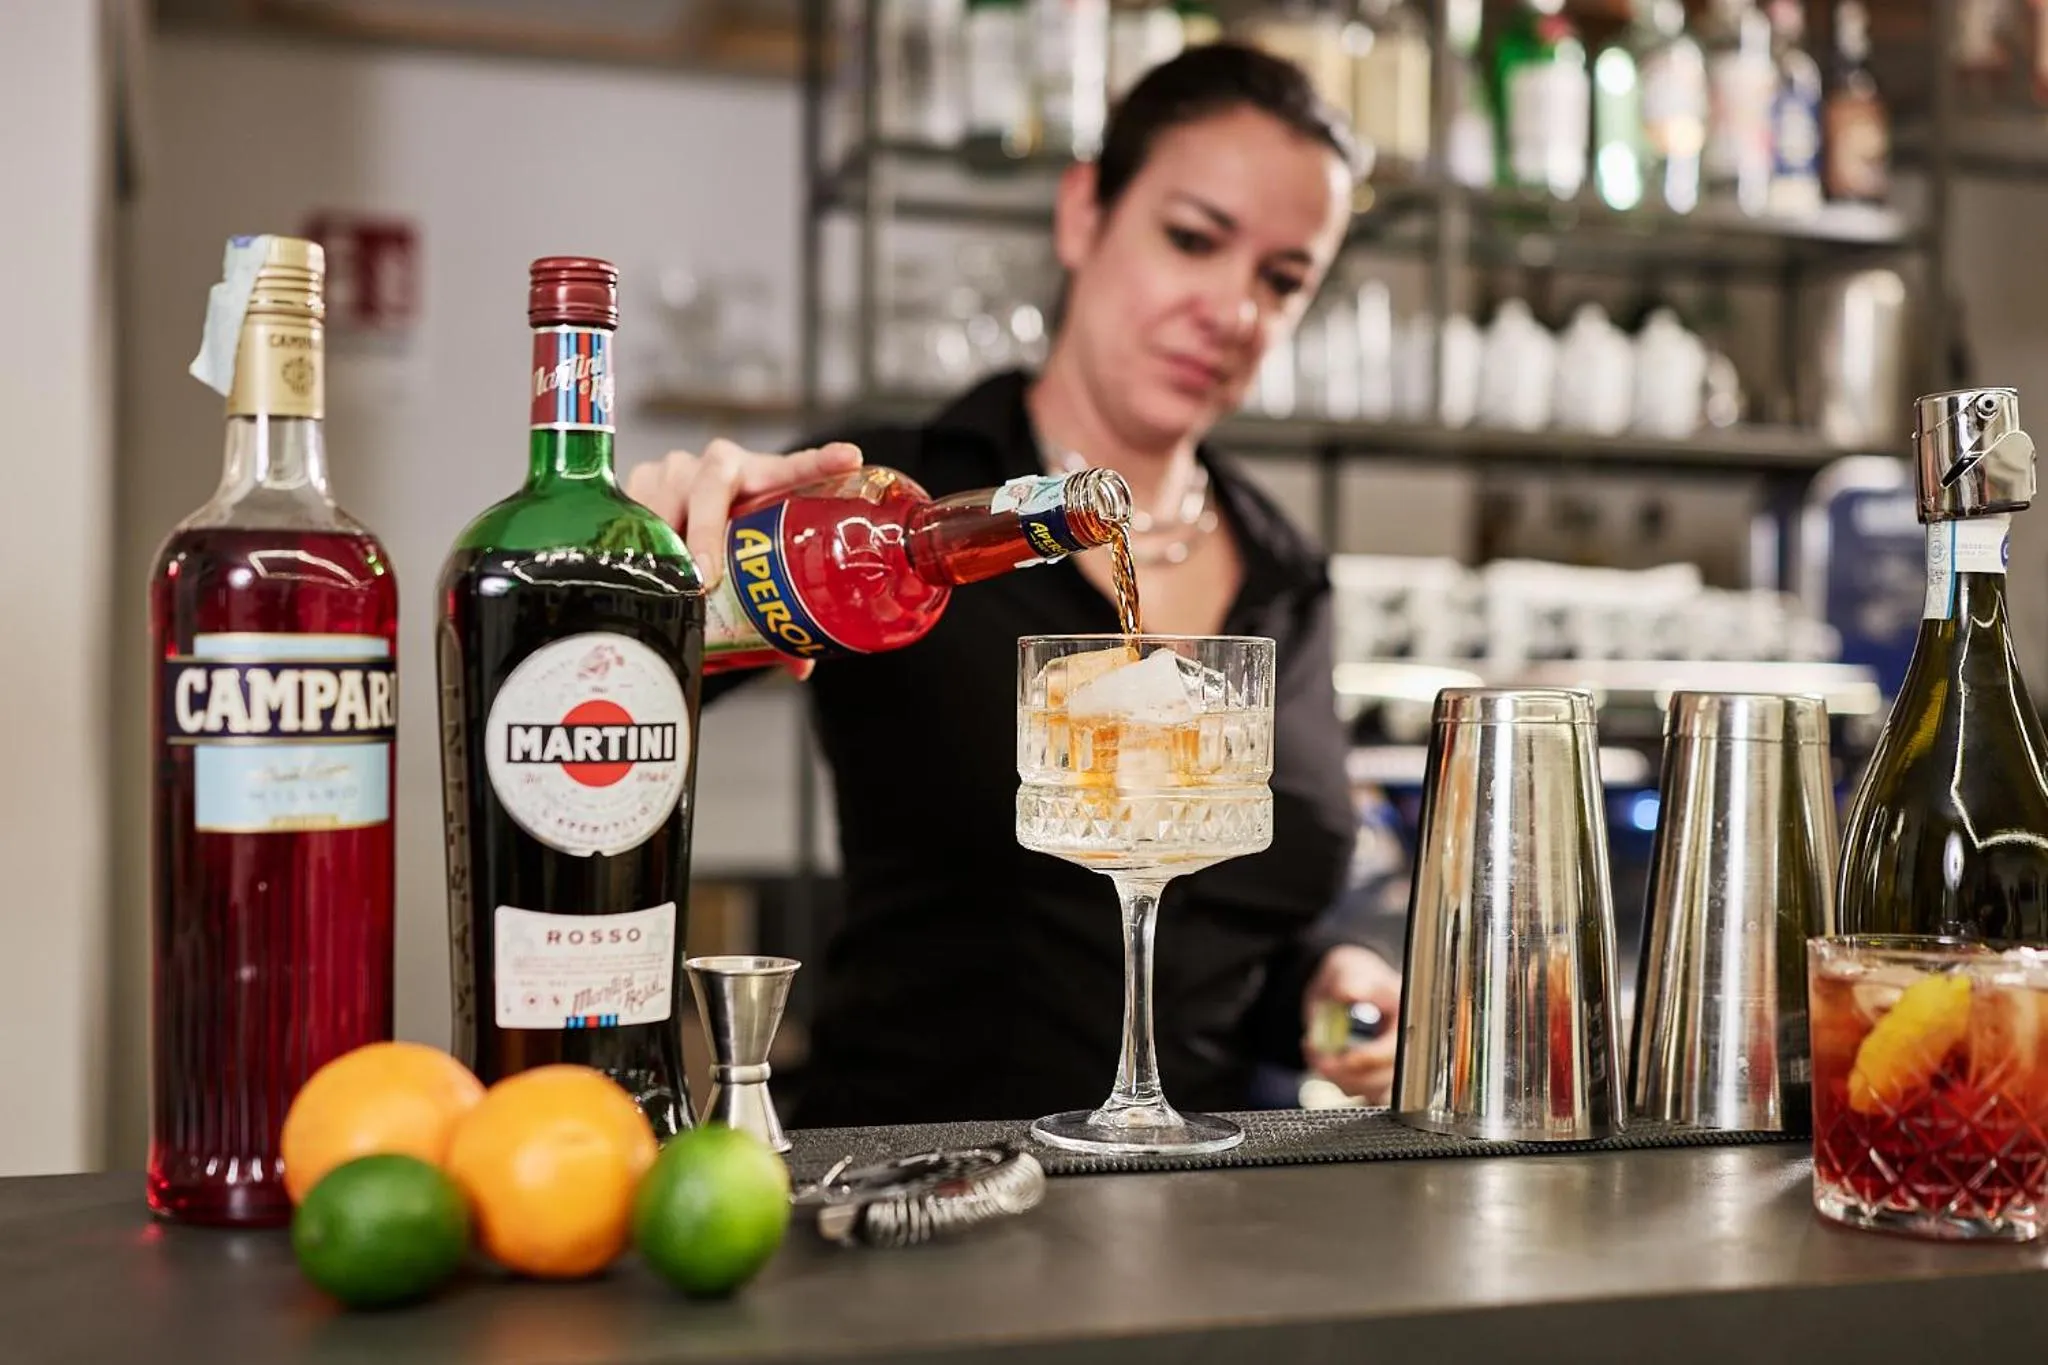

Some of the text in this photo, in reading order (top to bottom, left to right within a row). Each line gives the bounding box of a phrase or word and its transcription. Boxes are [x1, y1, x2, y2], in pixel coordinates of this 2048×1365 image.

[1029, 522, 1070, 555] APERO
[735, 528, 825, 655] APEROL
[510, 725, 674, 762] MARTINI
[547, 928, 641, 945] ROSSO
